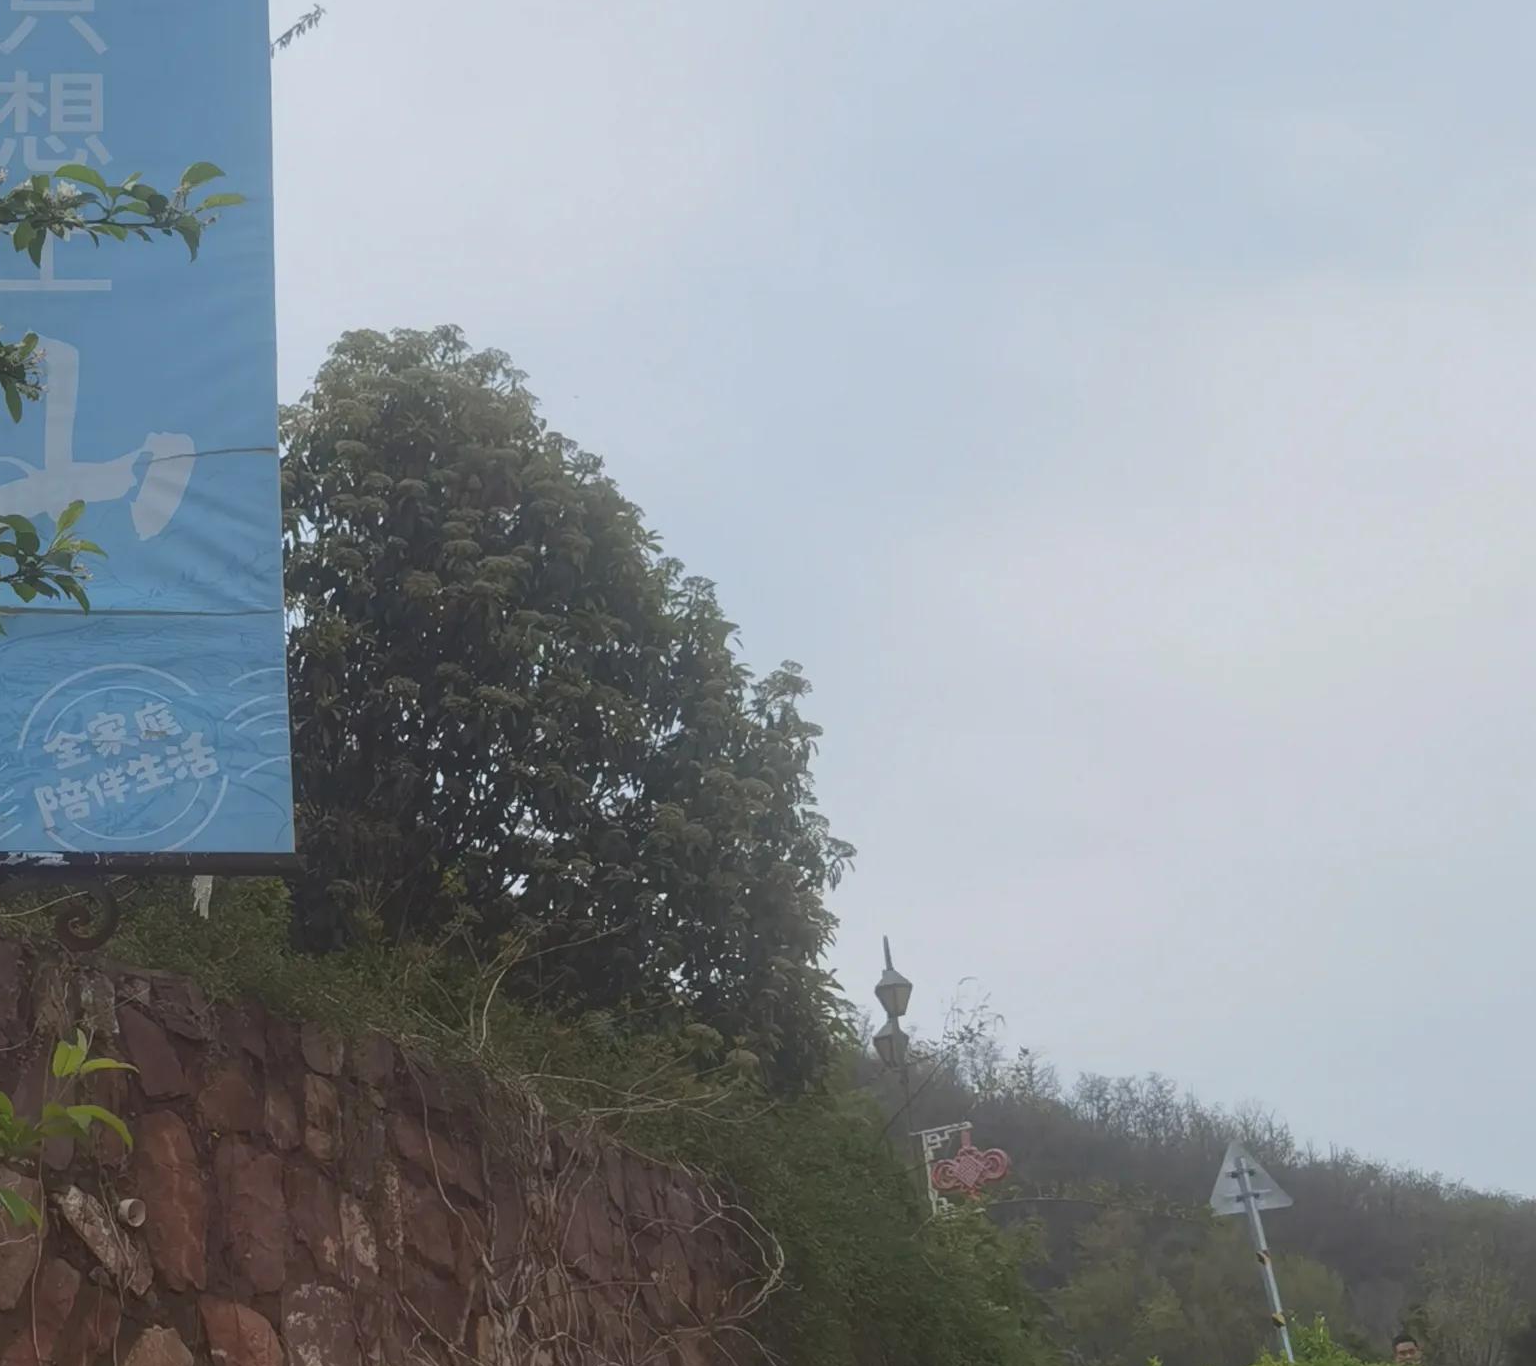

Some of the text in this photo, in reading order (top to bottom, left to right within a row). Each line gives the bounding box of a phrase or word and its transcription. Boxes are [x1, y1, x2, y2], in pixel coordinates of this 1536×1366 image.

[43, 702, 184, 769] 全家庭
[34, 731, 219, 828] 陪伴生活
